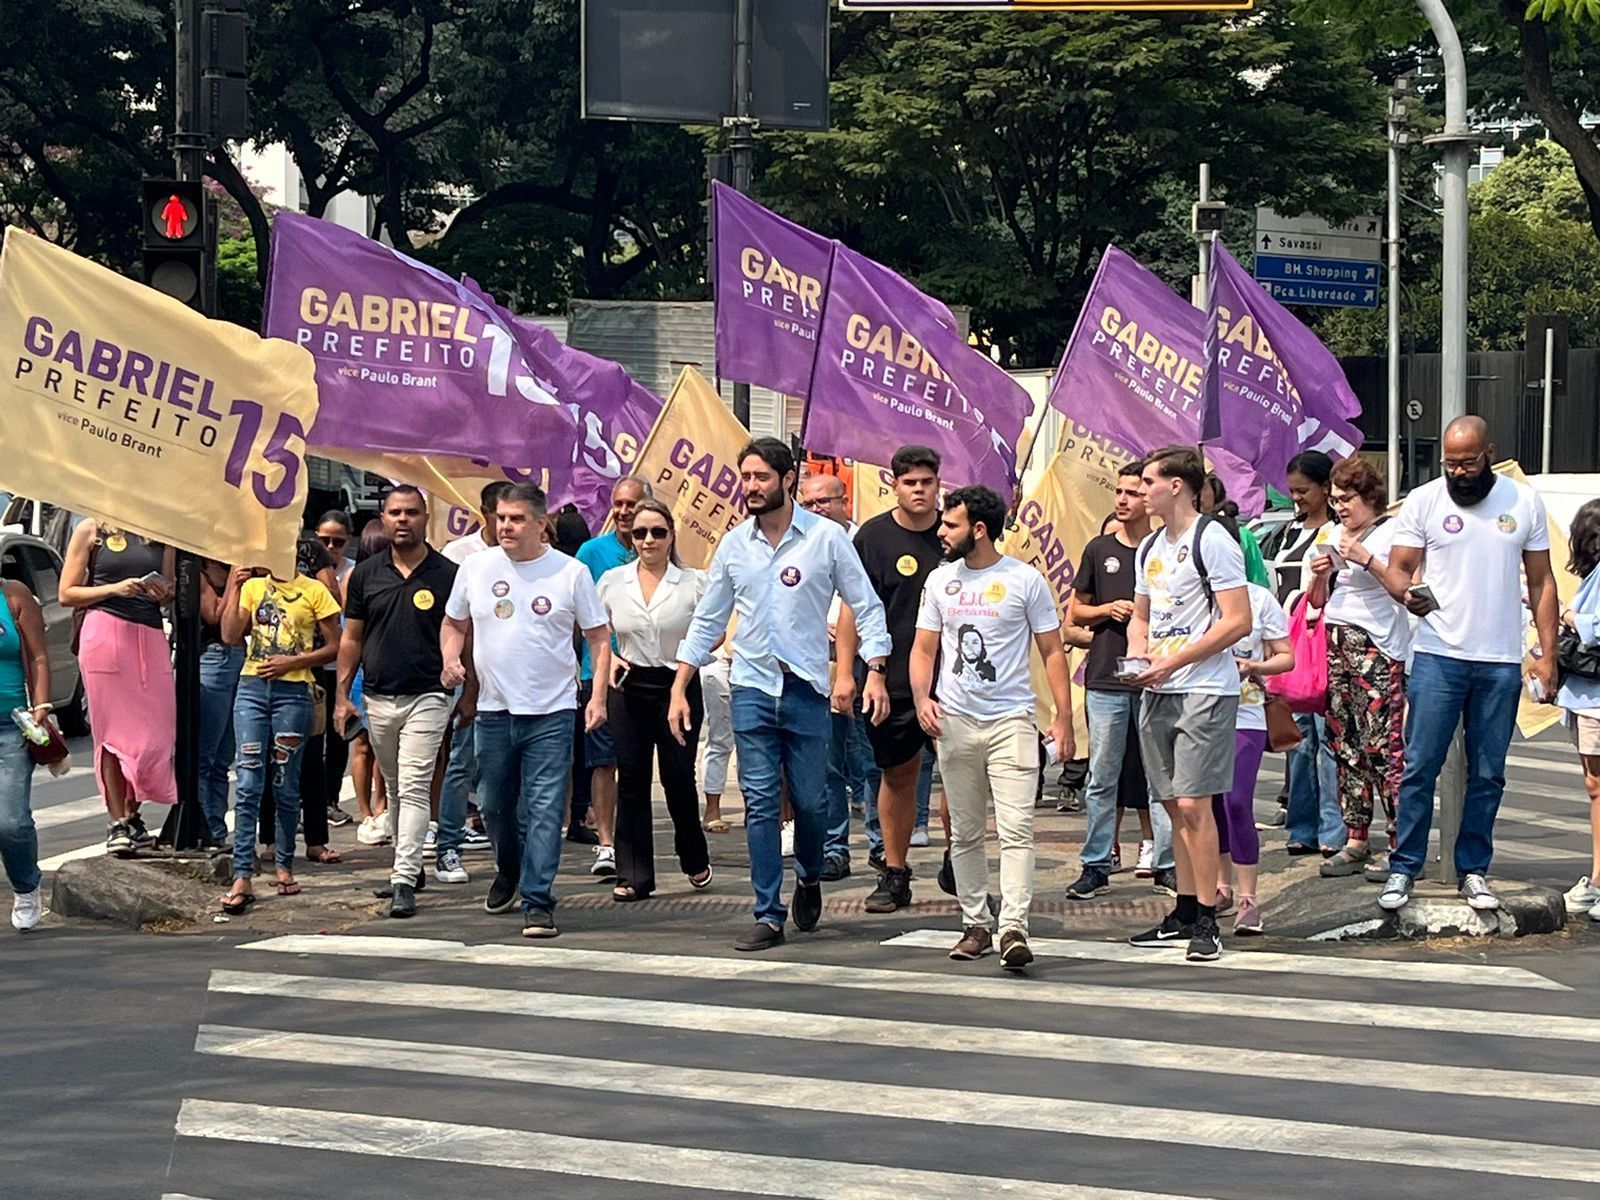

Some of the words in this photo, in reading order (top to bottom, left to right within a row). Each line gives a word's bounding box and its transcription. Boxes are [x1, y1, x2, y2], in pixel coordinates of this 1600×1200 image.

[1279, 237, 1322, 251] Savassi
[1306, 264, 1358, 282] Shopping
[1299, 287, 1356, 301] Liberdade
[300, 286, 478, 345] GABRIEL
[791, 323, 816, 341] Paul
[297, 328, 475, 368] PREFEITO
[1100, 306, 1204, 398] GABRIE
[24, 315, 222, 422] GABRIEL
[338, 366, 358, 378] vice
[360, 368, 399, 385] Paulo
[401, 373, 438, 389] Brant
[1092, 330, 1201, 420] PREFEIT
[15, 356, 217, 449] PREFEITO
[1128, 380, 1155, 403] Paulo
[1239, 386, 1270, 409] Paulo
[889, 397, 923, 418] Paulo
[924, 408, 955, 431] Brant
[57, 410, 80, 426] vice
[80, 417, 119, 443] Paulo
[120, 432, 164, 459] Brant
[224, 399, 306, 510] 15
[656, 467, 738, 533] PREFE
[689, 520, 717, 545] Paulo
